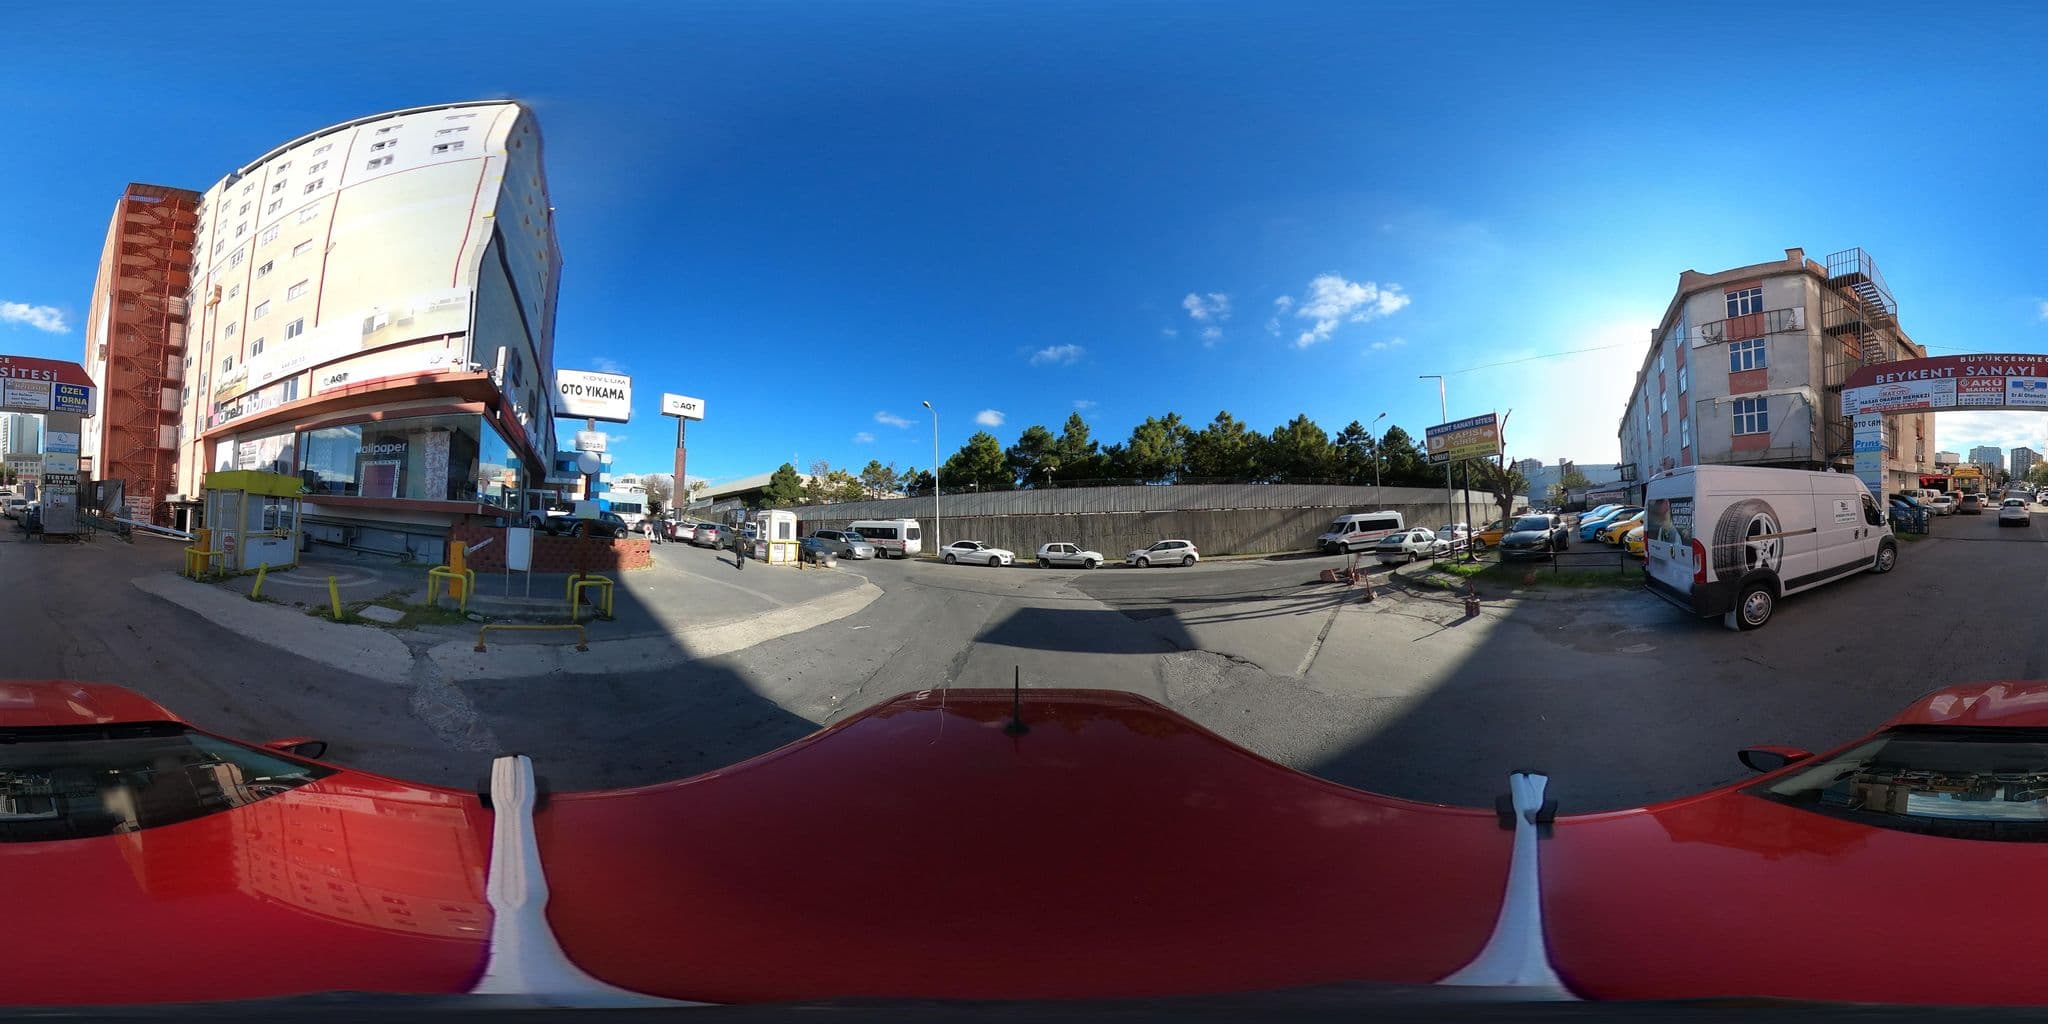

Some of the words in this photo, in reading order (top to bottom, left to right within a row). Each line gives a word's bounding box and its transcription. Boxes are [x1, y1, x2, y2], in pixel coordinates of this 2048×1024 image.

[0, 365, 58, 382] SİTESİ
[1876, 367, 1955, 384] BEYKENT
[1966, 363, 2035, 376] SANAYİ
[1971, 378, 2002, 387] AKÜ
[561, 383, 583, 396] OTO
[585, 385, 625, 400] YIKAMA
[56, 395, 87, 405] TORNA
[680, 402, 697, 411] AGT
[1431, 436, 1446, 449] D
[1855, 440, 1880, 448] Prins
